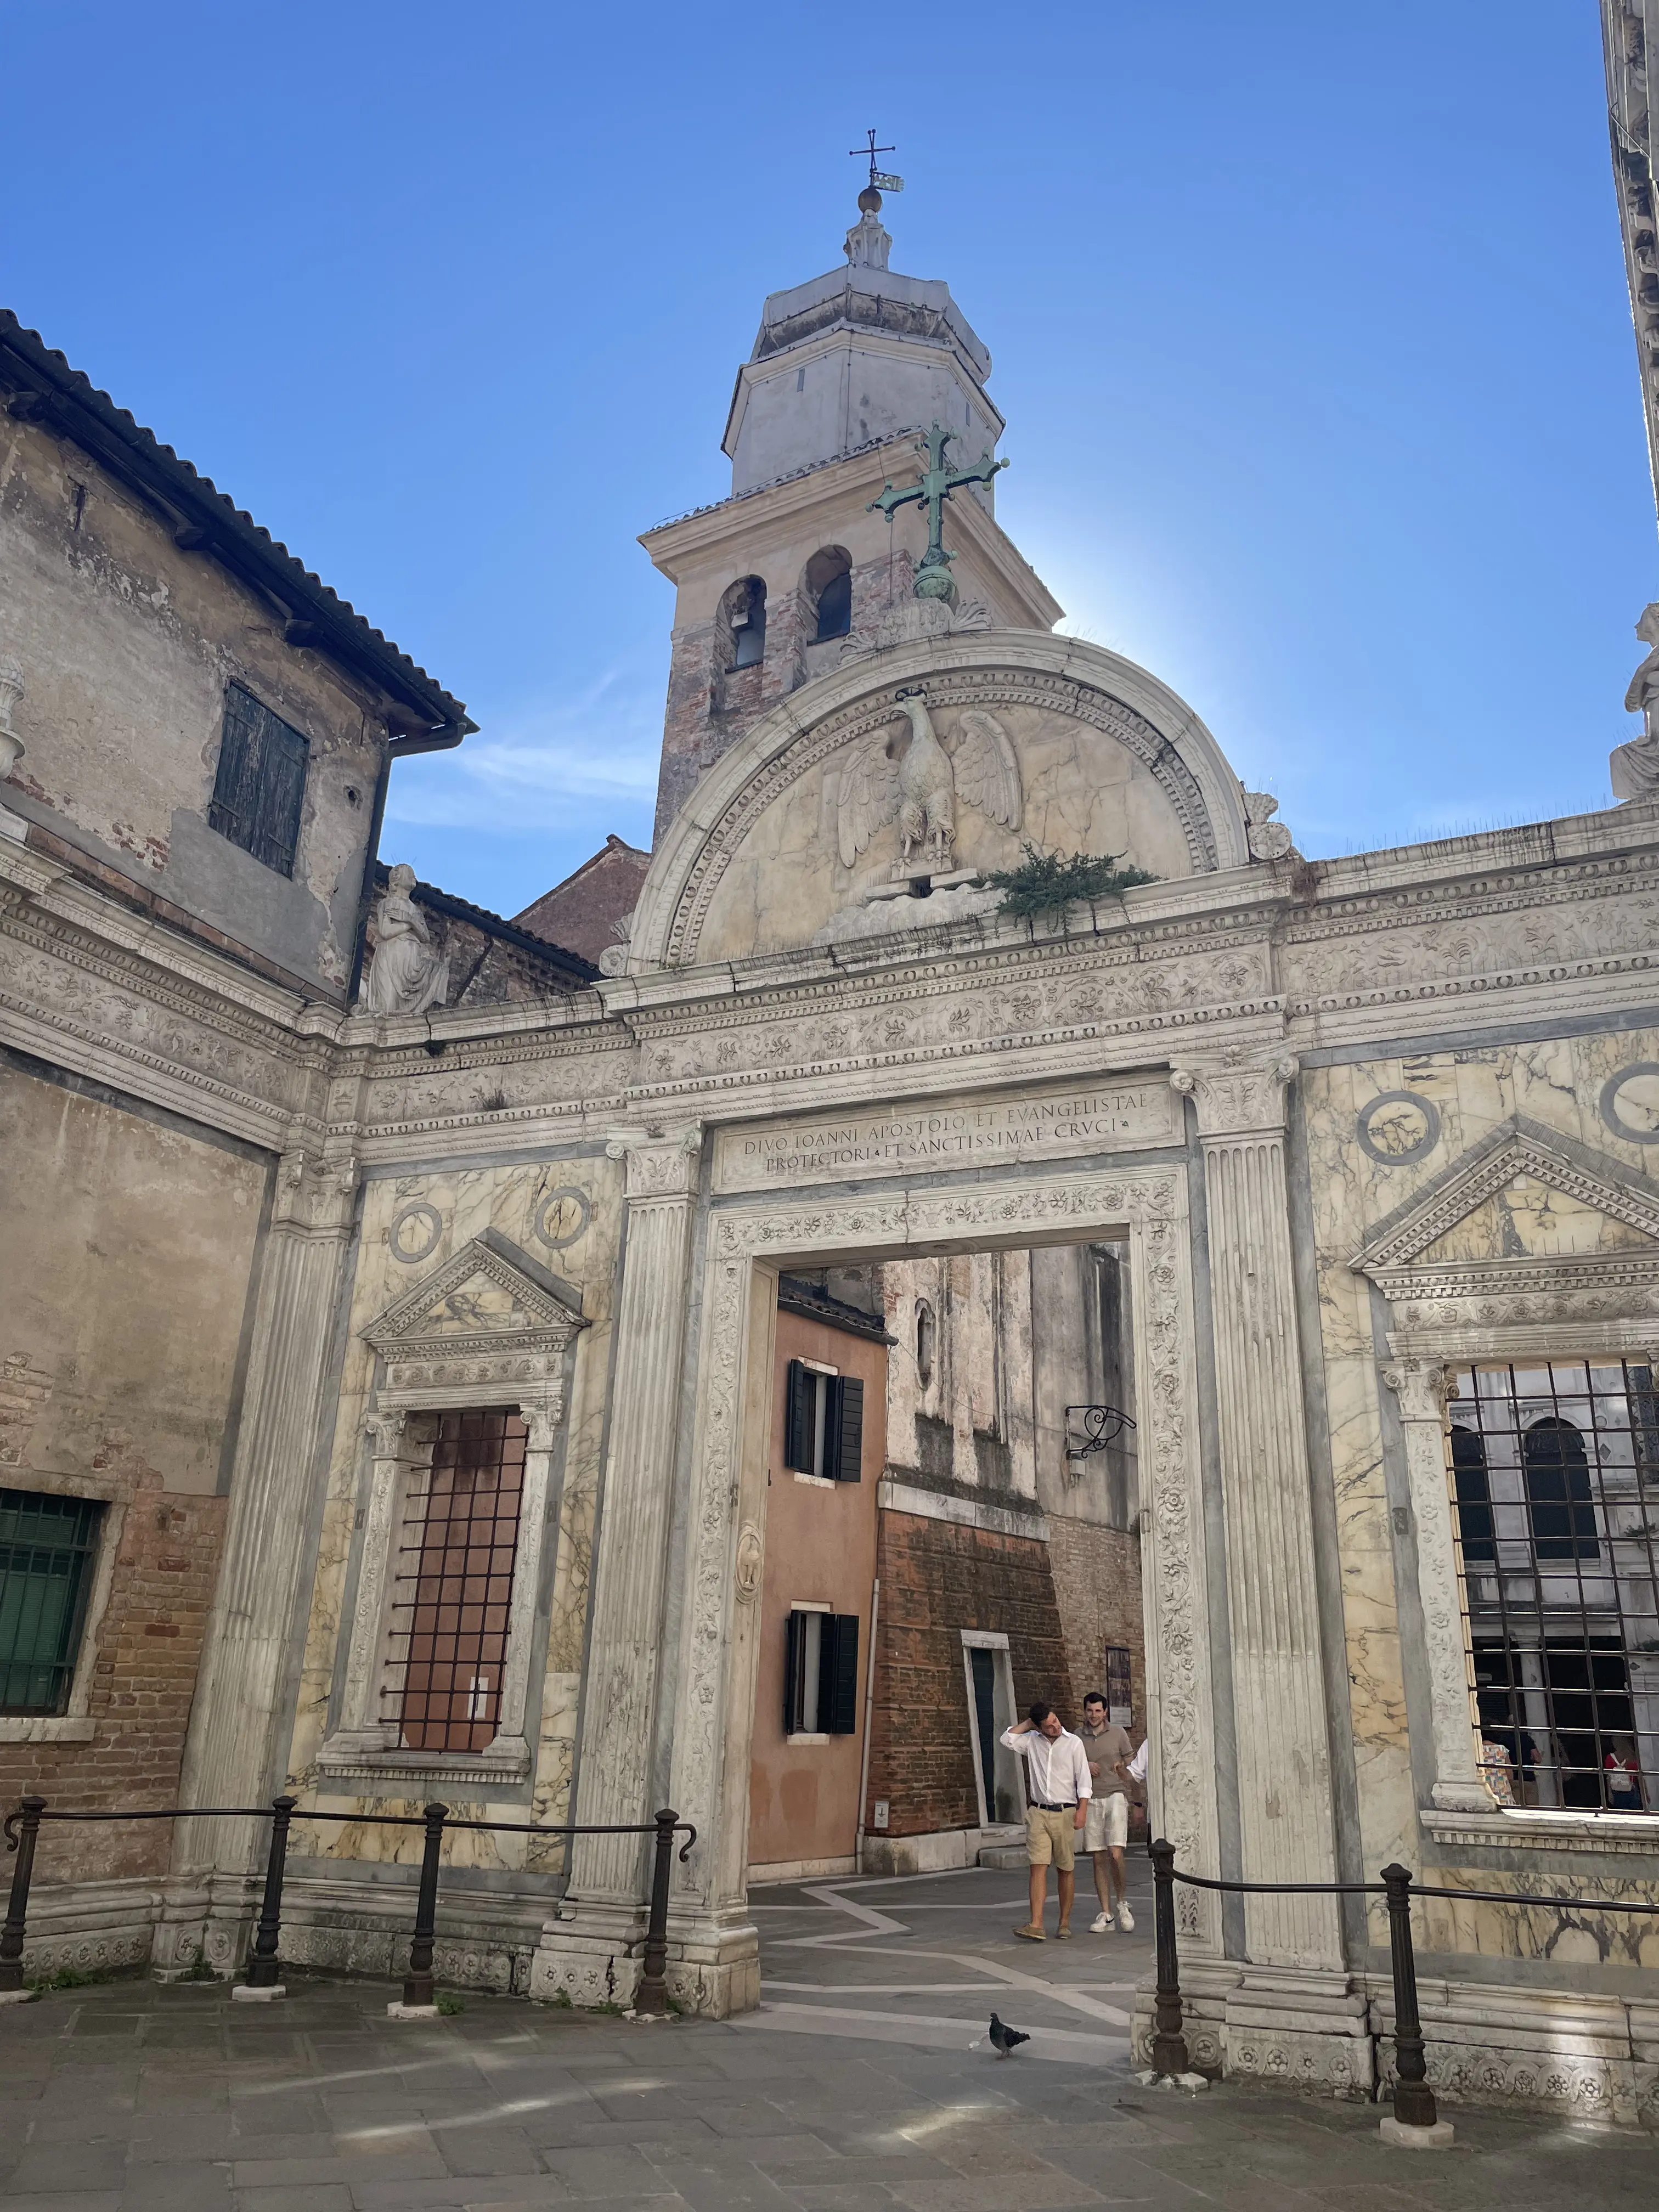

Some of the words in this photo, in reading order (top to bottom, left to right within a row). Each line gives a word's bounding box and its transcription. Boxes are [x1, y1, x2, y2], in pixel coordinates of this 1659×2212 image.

[744, 1137, 787, 1154] DIVO
[795, 1128, 857, 1149] IOANNI
[868, 1116, 965, 1139] APOSTOLO
[977, 1111, 997, 1127] ET
[1007, 1093, 1148, 1124] EVANGELISTAE
[885, 1143, 904, 1158] ET
[909, 1126, 1043, 1156] SANCTISSIMAE
[1054, 1118, 1115, 1138] CRVCI
